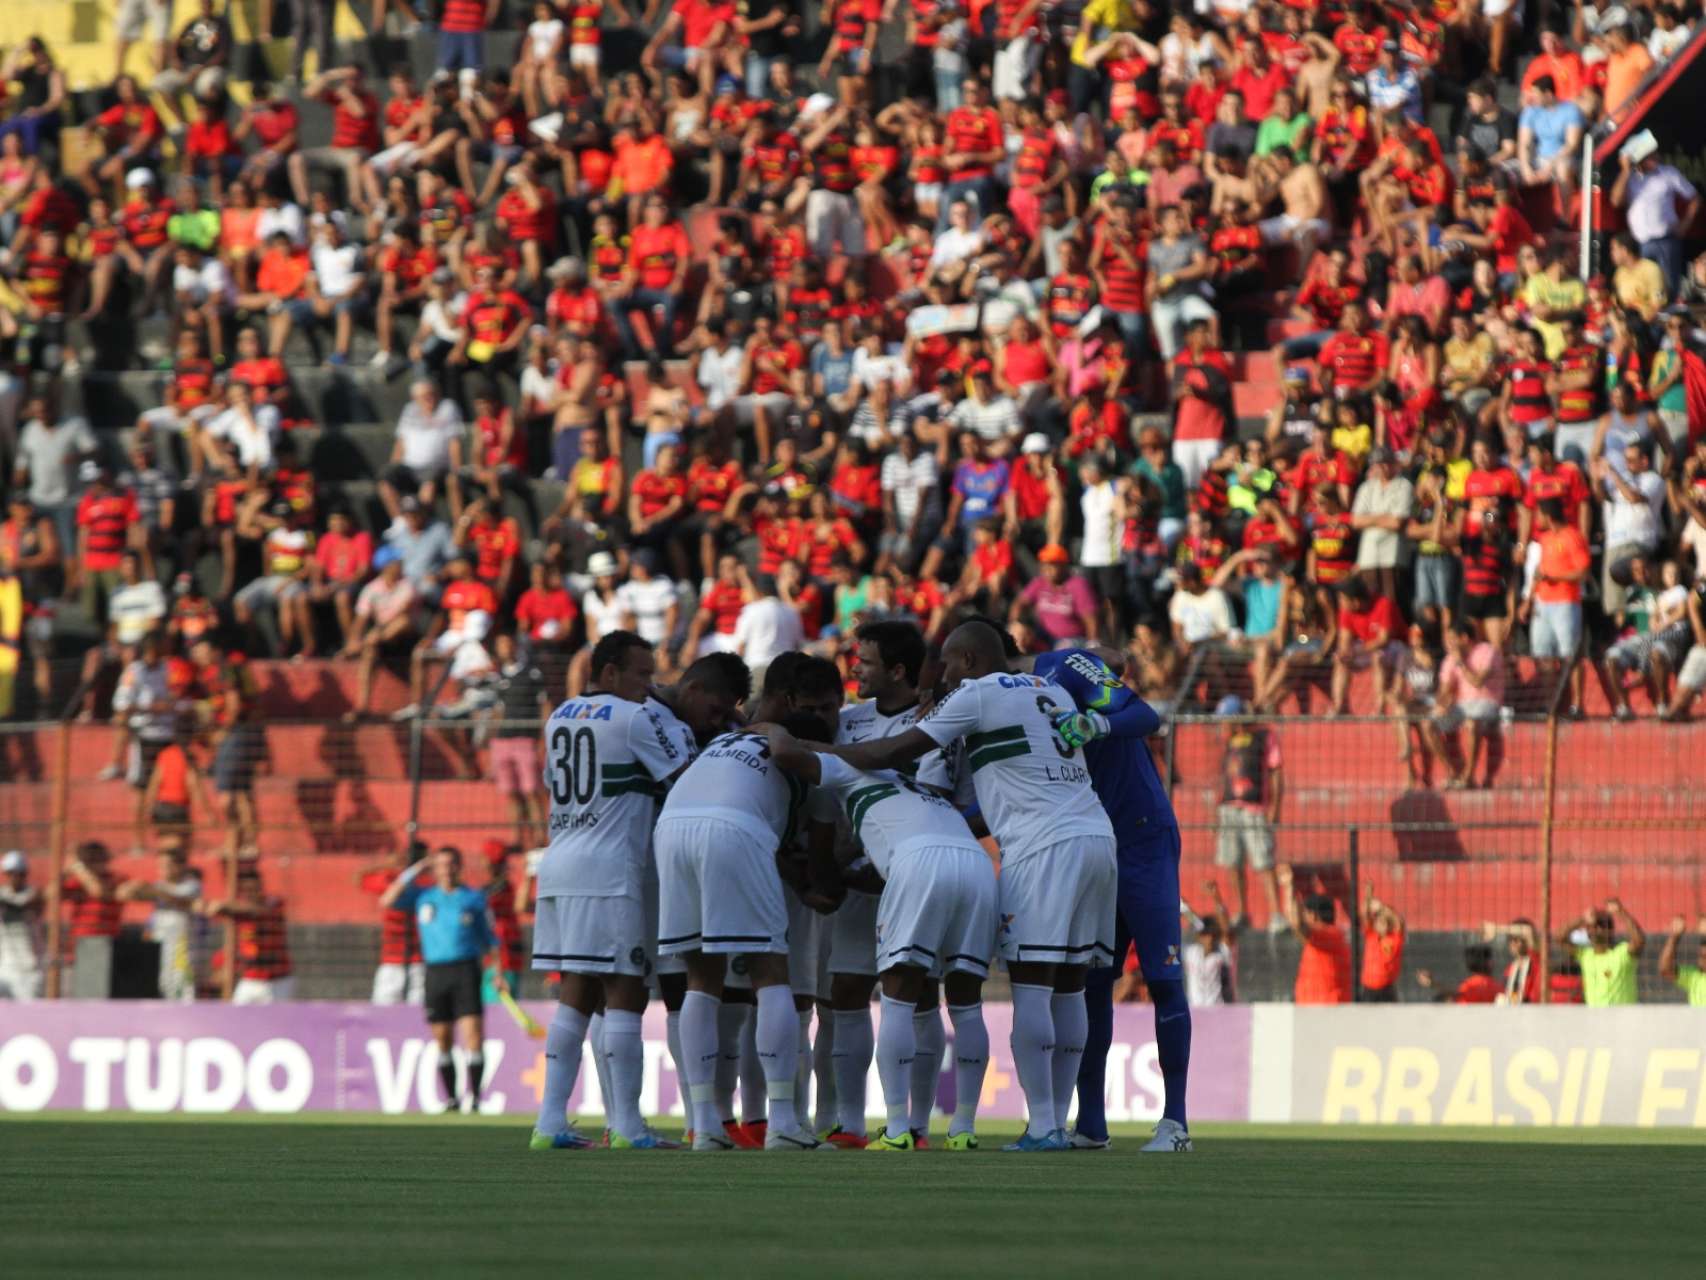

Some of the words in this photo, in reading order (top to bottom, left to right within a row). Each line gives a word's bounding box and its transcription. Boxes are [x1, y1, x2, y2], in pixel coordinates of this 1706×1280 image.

[1064, 656, 1103, 685] TORK
[552, 726, 596, 805] 30
[702, 749, 768, 776] ALMEIDA
[69, 1037, 313, 1113] TUDO
[366, 1038, 507, 1115] VOZ
